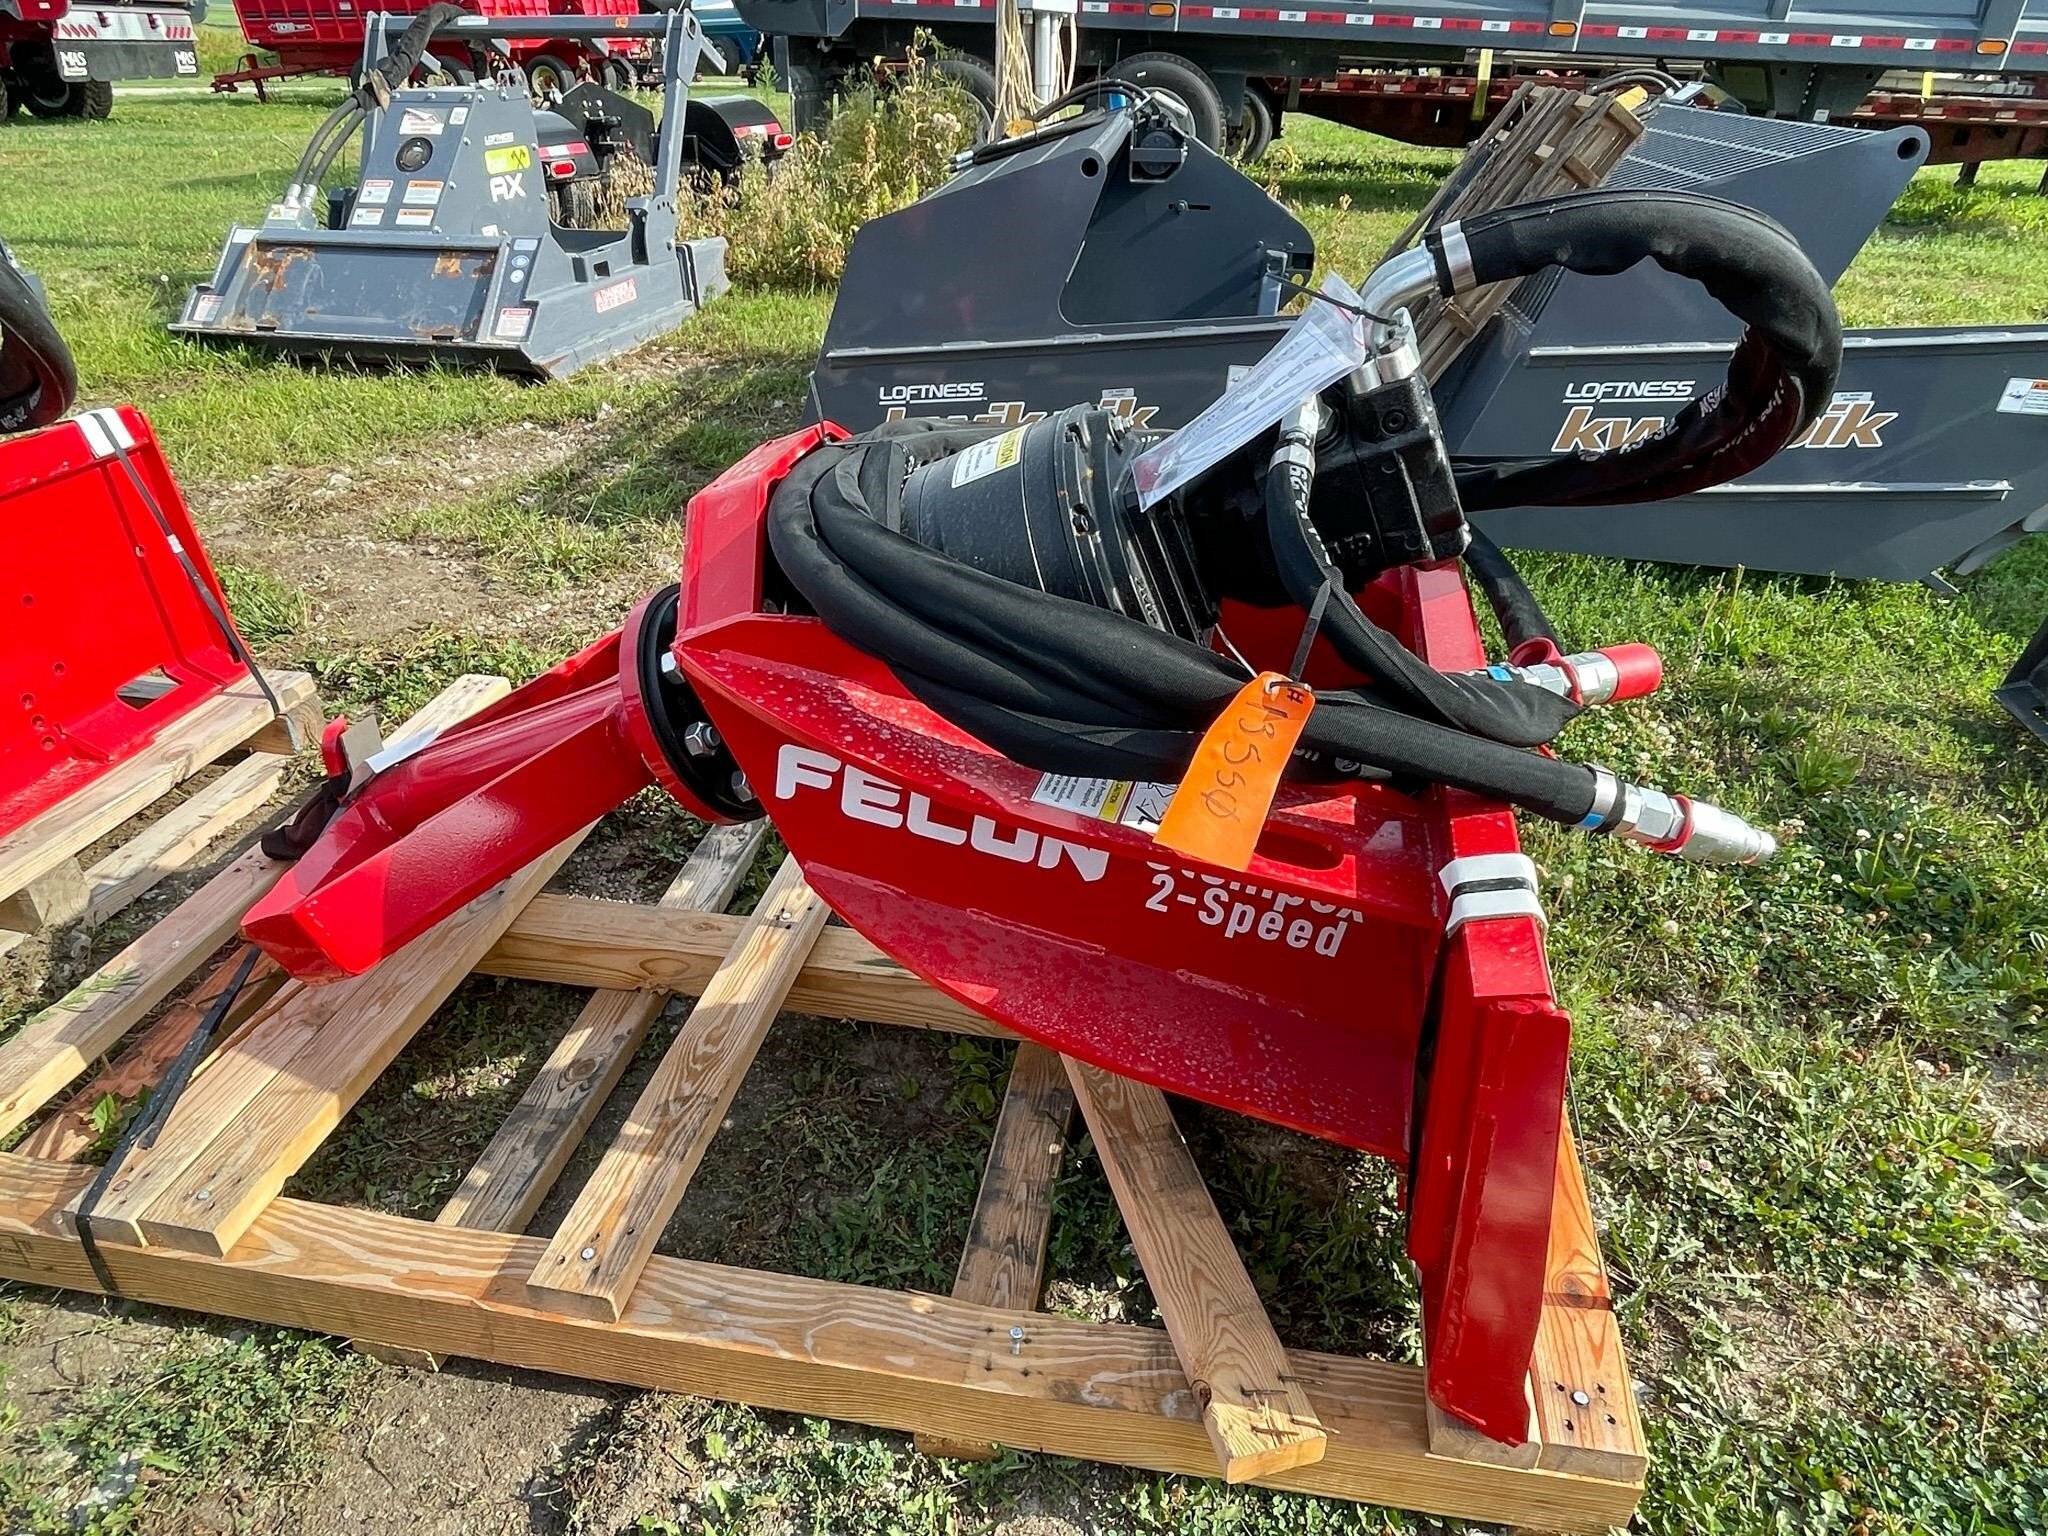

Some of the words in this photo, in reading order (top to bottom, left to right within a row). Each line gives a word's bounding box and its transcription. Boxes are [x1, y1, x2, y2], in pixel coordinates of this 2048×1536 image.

[489, 172, 527, 203] AX
[879, 382, 985, 401] LOFTNESS
[1564, 380, 1696, 399] LOFTNESS
[1145, 873, 1348, 958] 2-Speed
